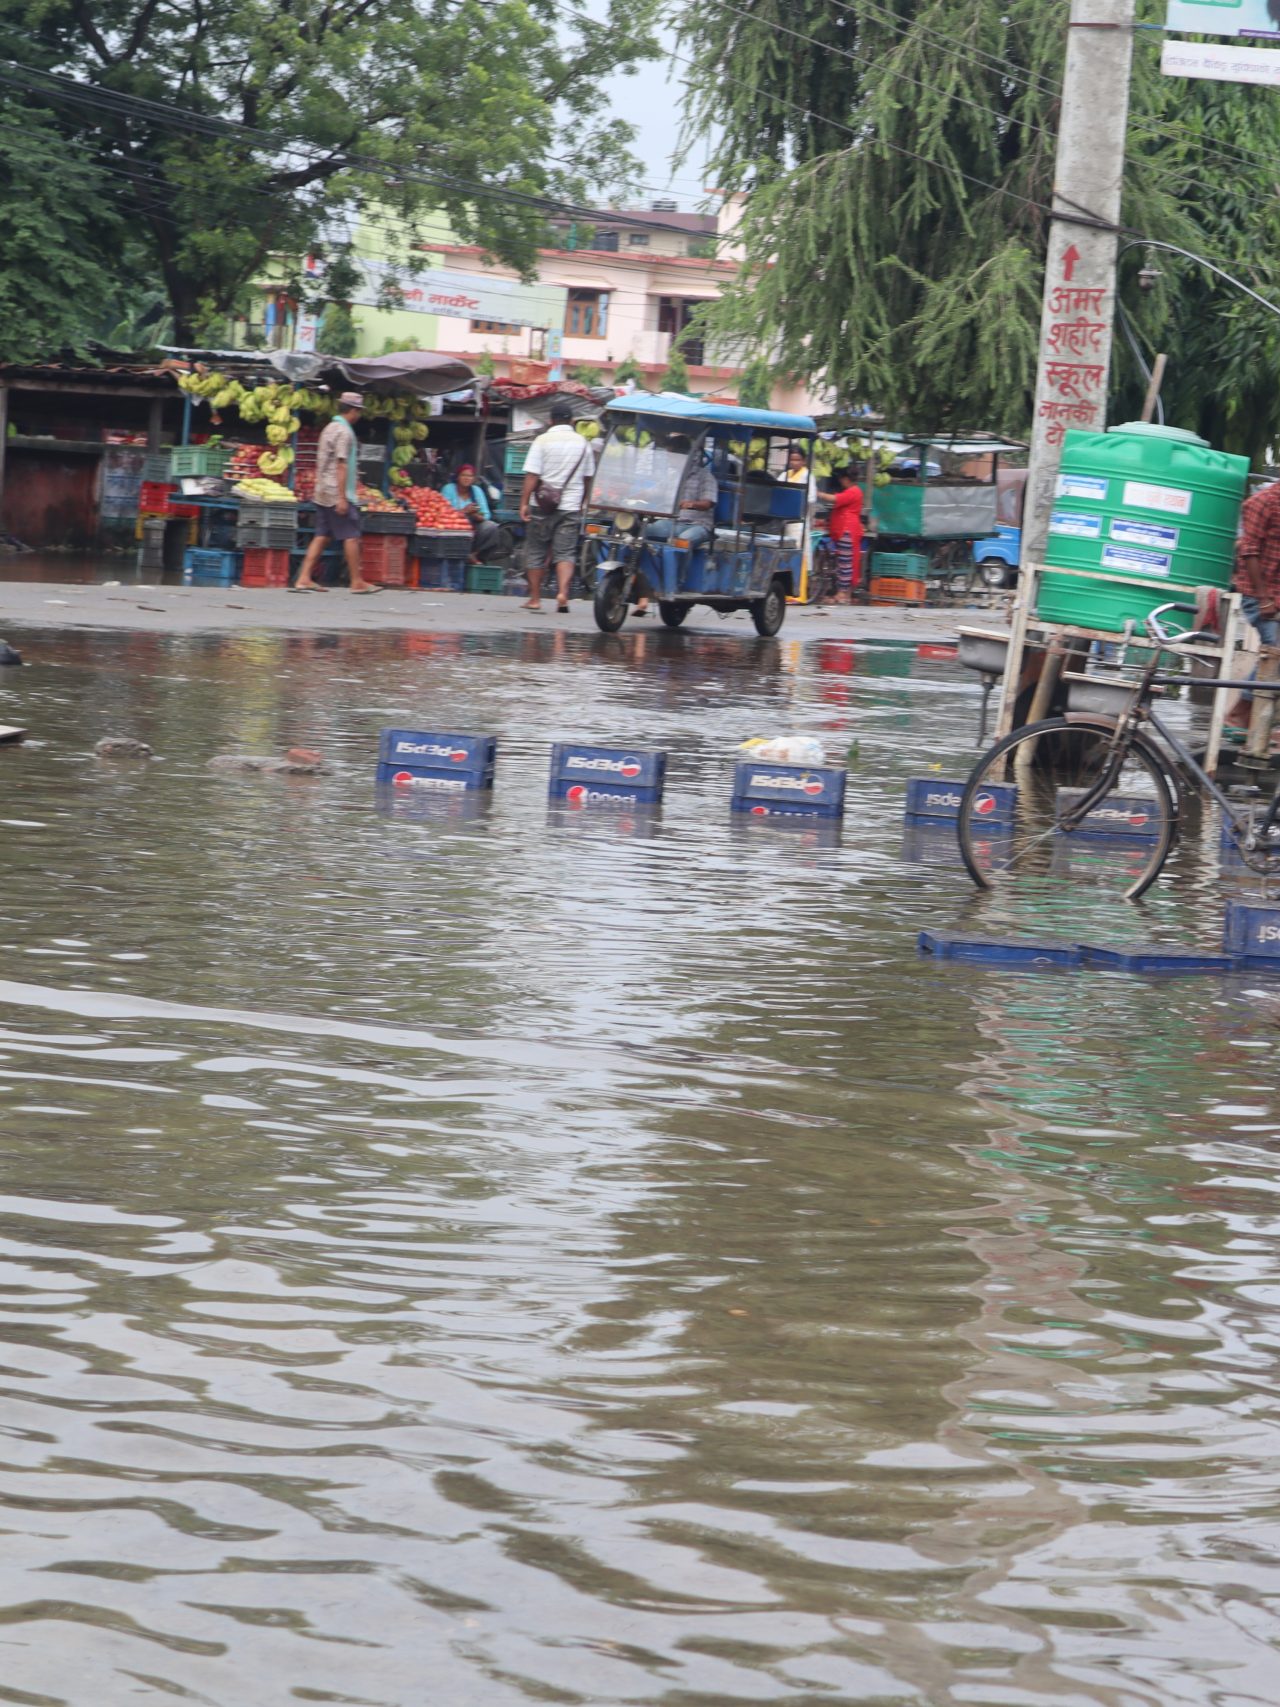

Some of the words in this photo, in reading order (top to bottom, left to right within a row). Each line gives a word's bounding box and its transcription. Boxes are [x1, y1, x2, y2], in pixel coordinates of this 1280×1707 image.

[1048, 287, 1107, 316] अमर
[1047, 316, 1106, 356] शहीद
[1045, 362, 1104, 399] स्कूल
[1038, 399, 1097, 425] जानकी
[1045, 421, 1066, 447] टो
[925, 792, 964, 807] epsi
